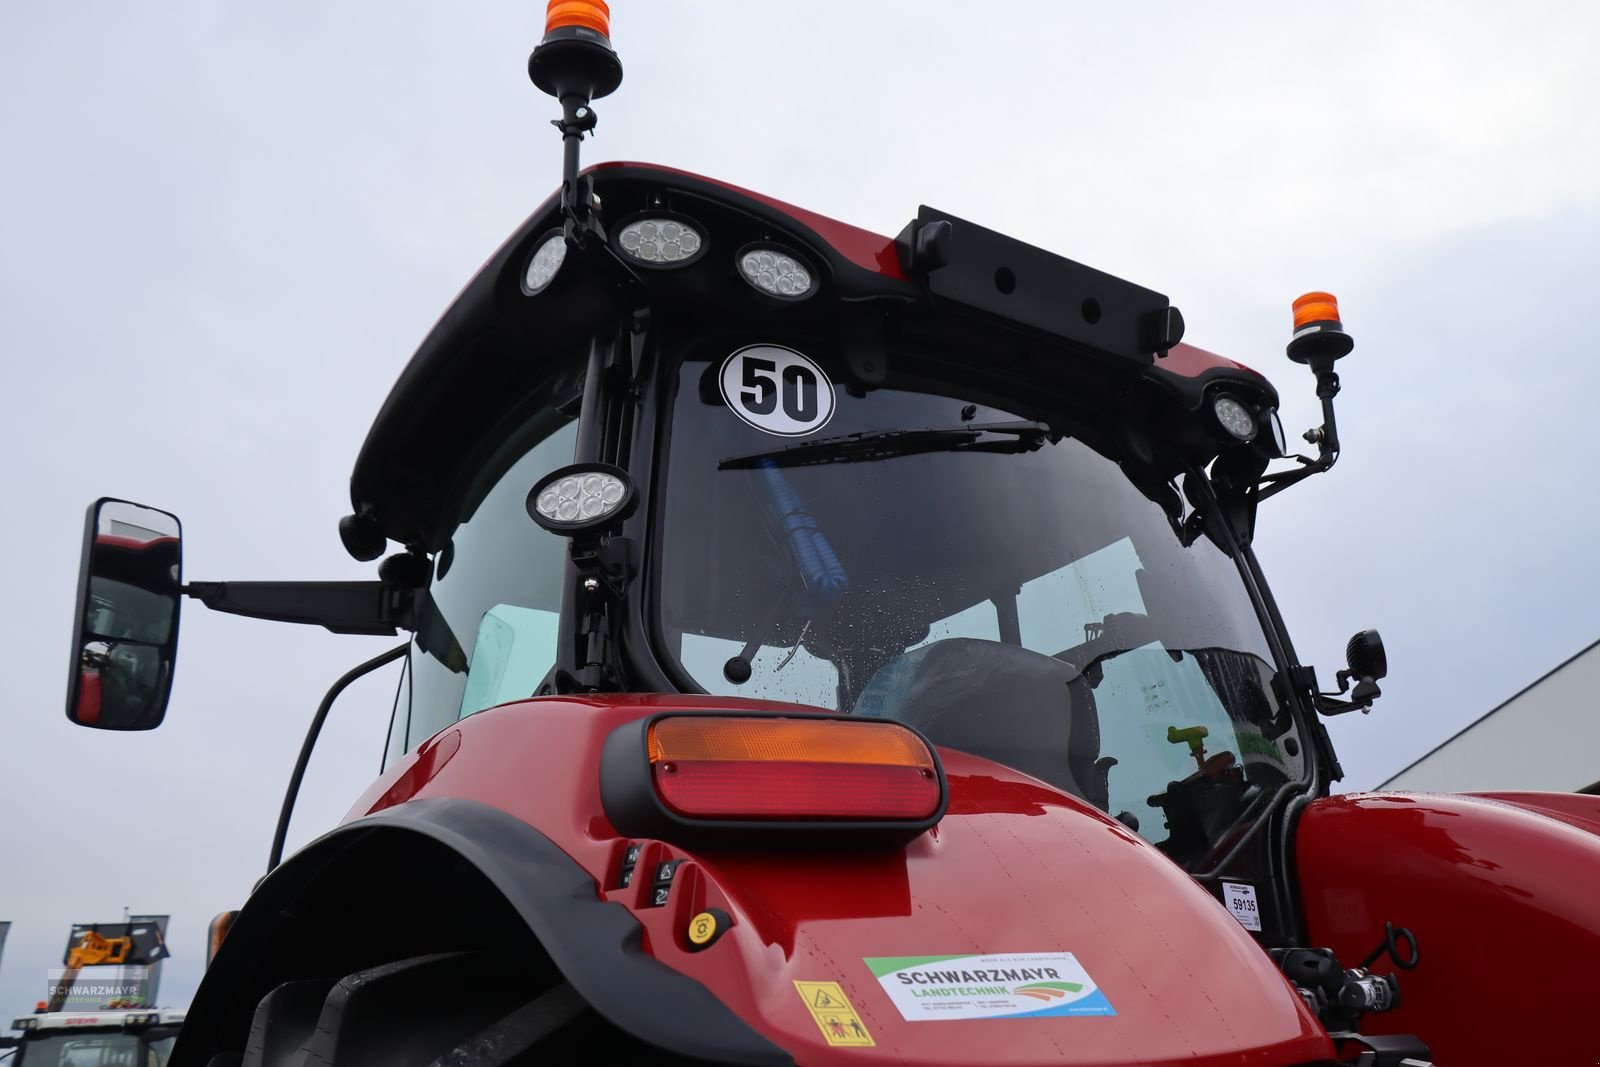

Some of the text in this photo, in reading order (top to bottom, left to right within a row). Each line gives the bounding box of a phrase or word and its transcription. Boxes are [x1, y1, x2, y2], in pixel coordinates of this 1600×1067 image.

[740, 356, 818, 422] 50
[1233, 898, 1256, 912] 59135
[896, 967, 1061, 985] SCHWARZMAYR
[911, 986, 1010, 998] LANDTECHNIK
